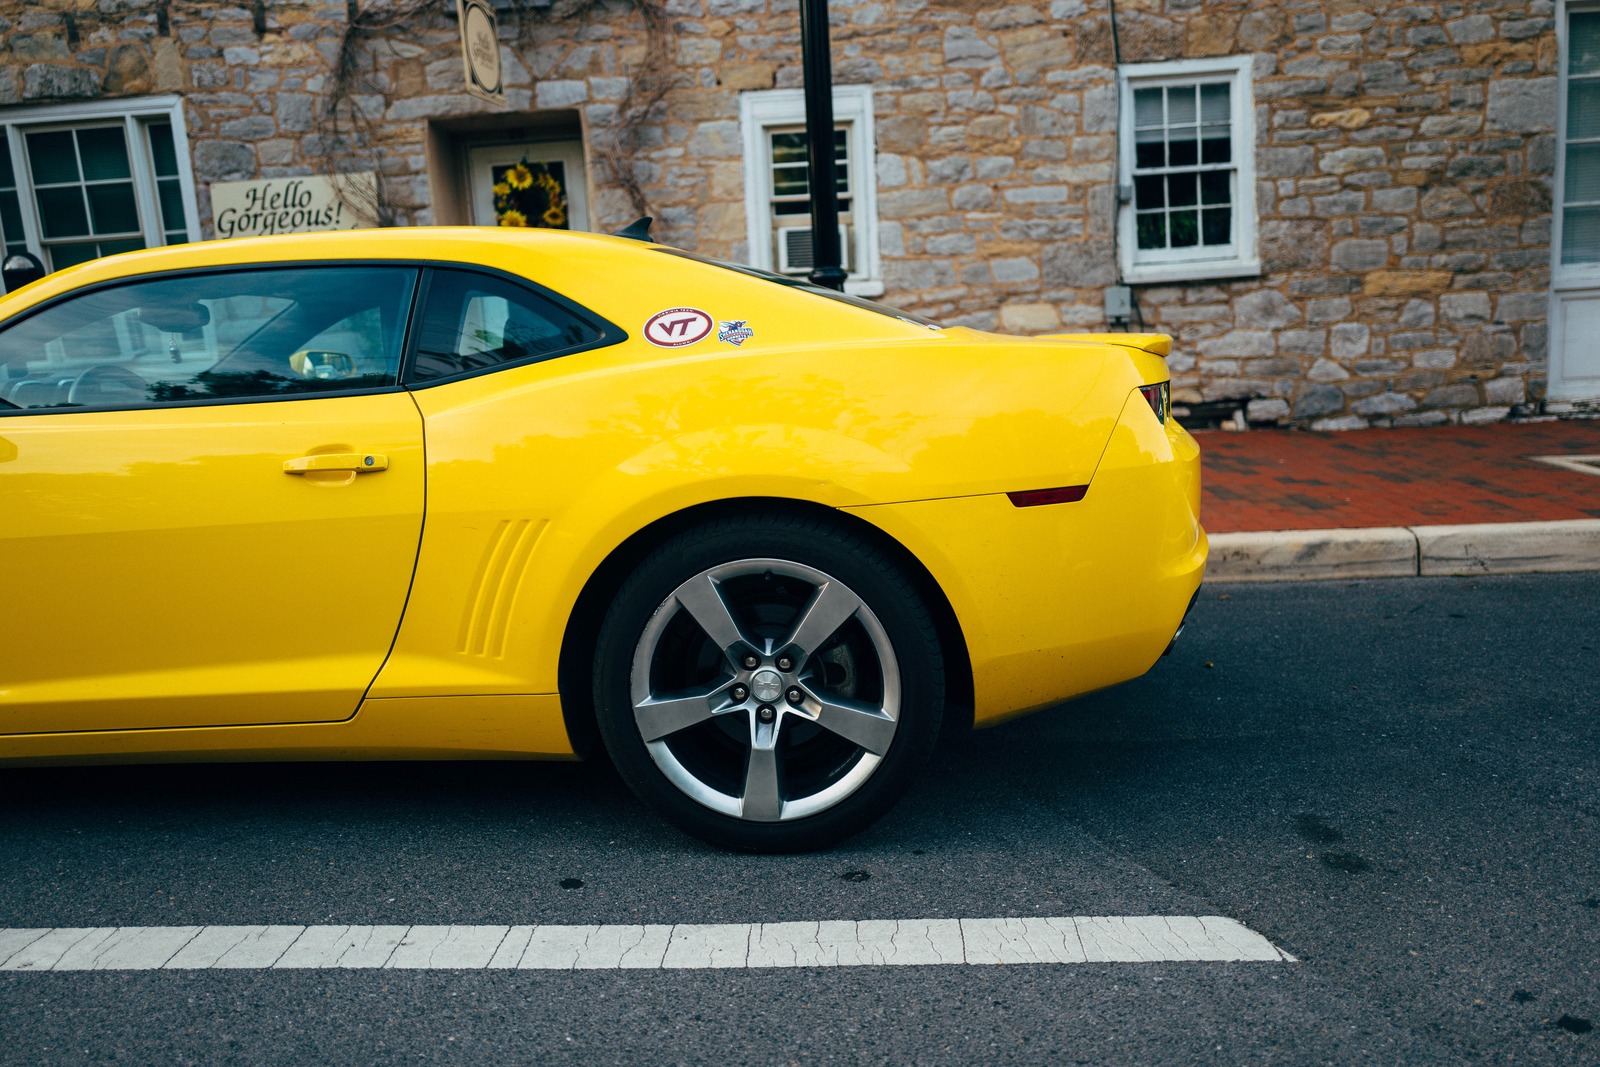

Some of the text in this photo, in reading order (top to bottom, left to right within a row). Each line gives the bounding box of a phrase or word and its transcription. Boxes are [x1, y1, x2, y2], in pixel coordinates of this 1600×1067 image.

[245, 180, 312, 211] Hello
[217, 201, 343, 239] Gorgeous!
[658, 317, 698, 337] VT
